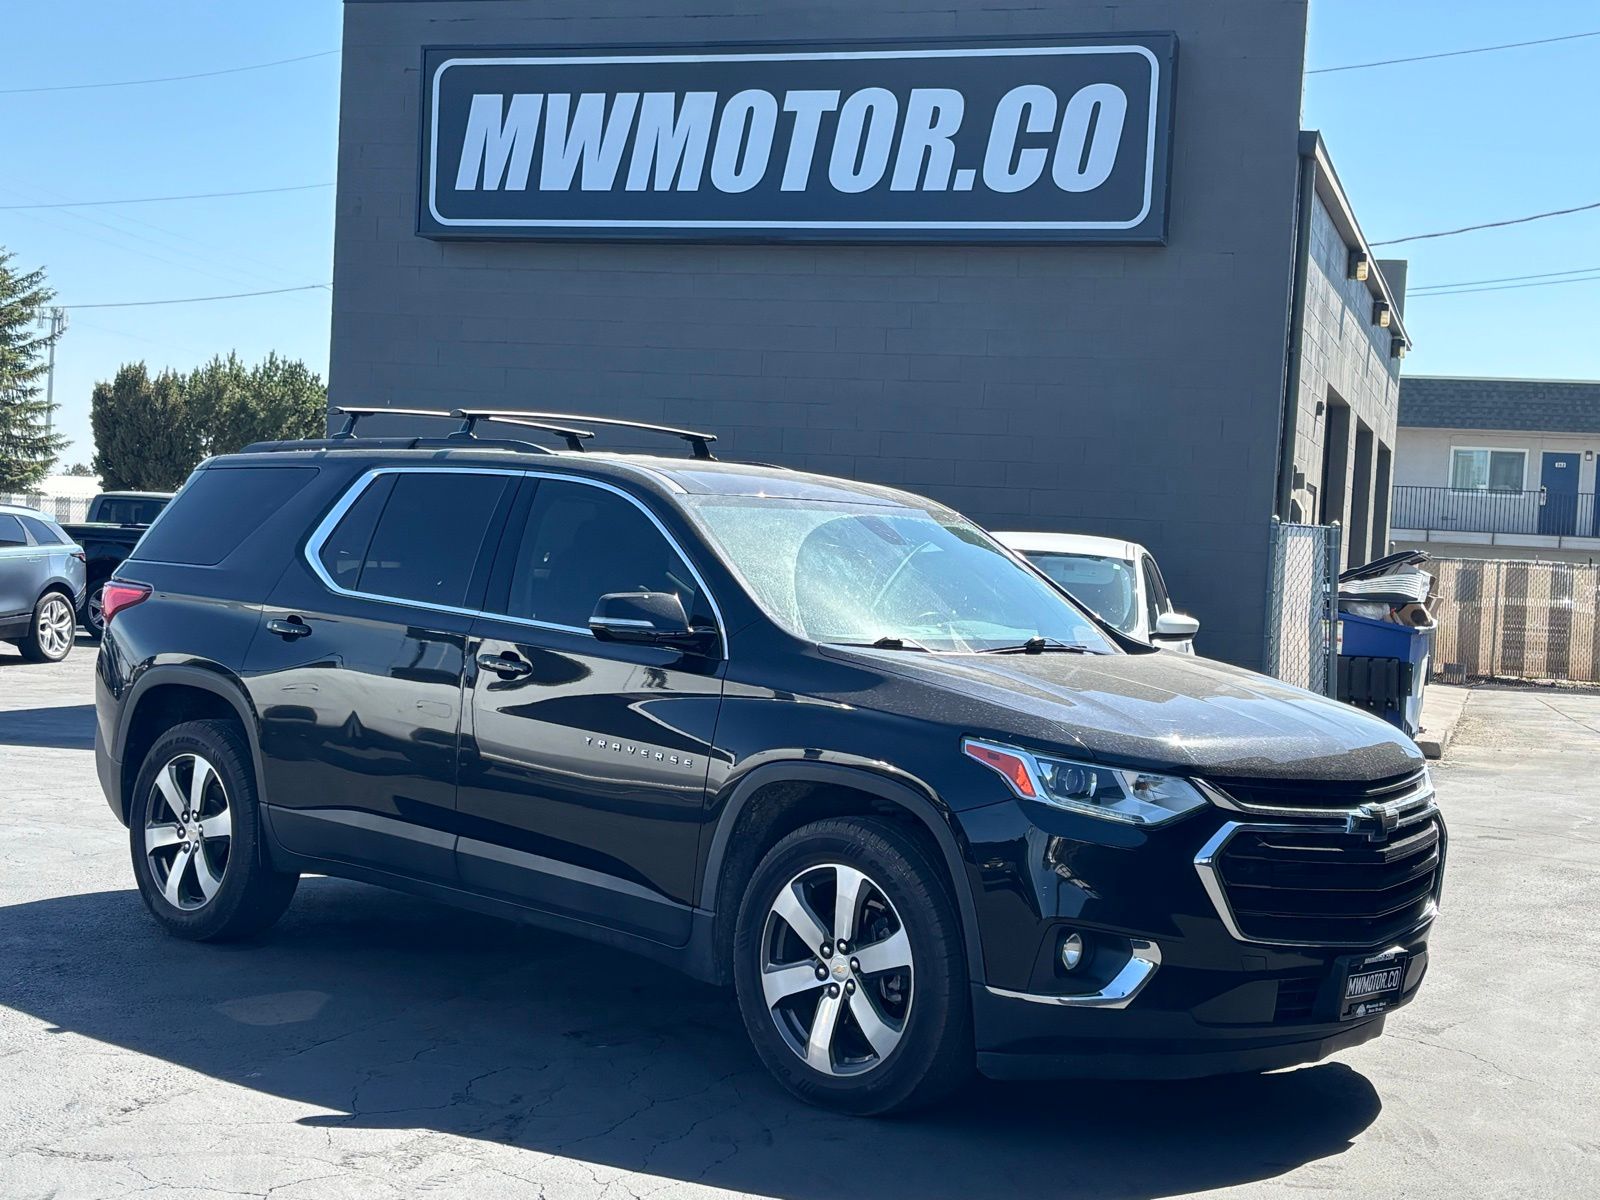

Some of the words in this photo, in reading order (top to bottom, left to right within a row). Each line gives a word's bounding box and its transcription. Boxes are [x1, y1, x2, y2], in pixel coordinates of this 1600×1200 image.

[455, 82, 1128, 194] MWMOTOR.CO
[584, 736, 693, 768] TRAVERSE
[1347, 970, 1399, 996] MWMOTOR.CO
